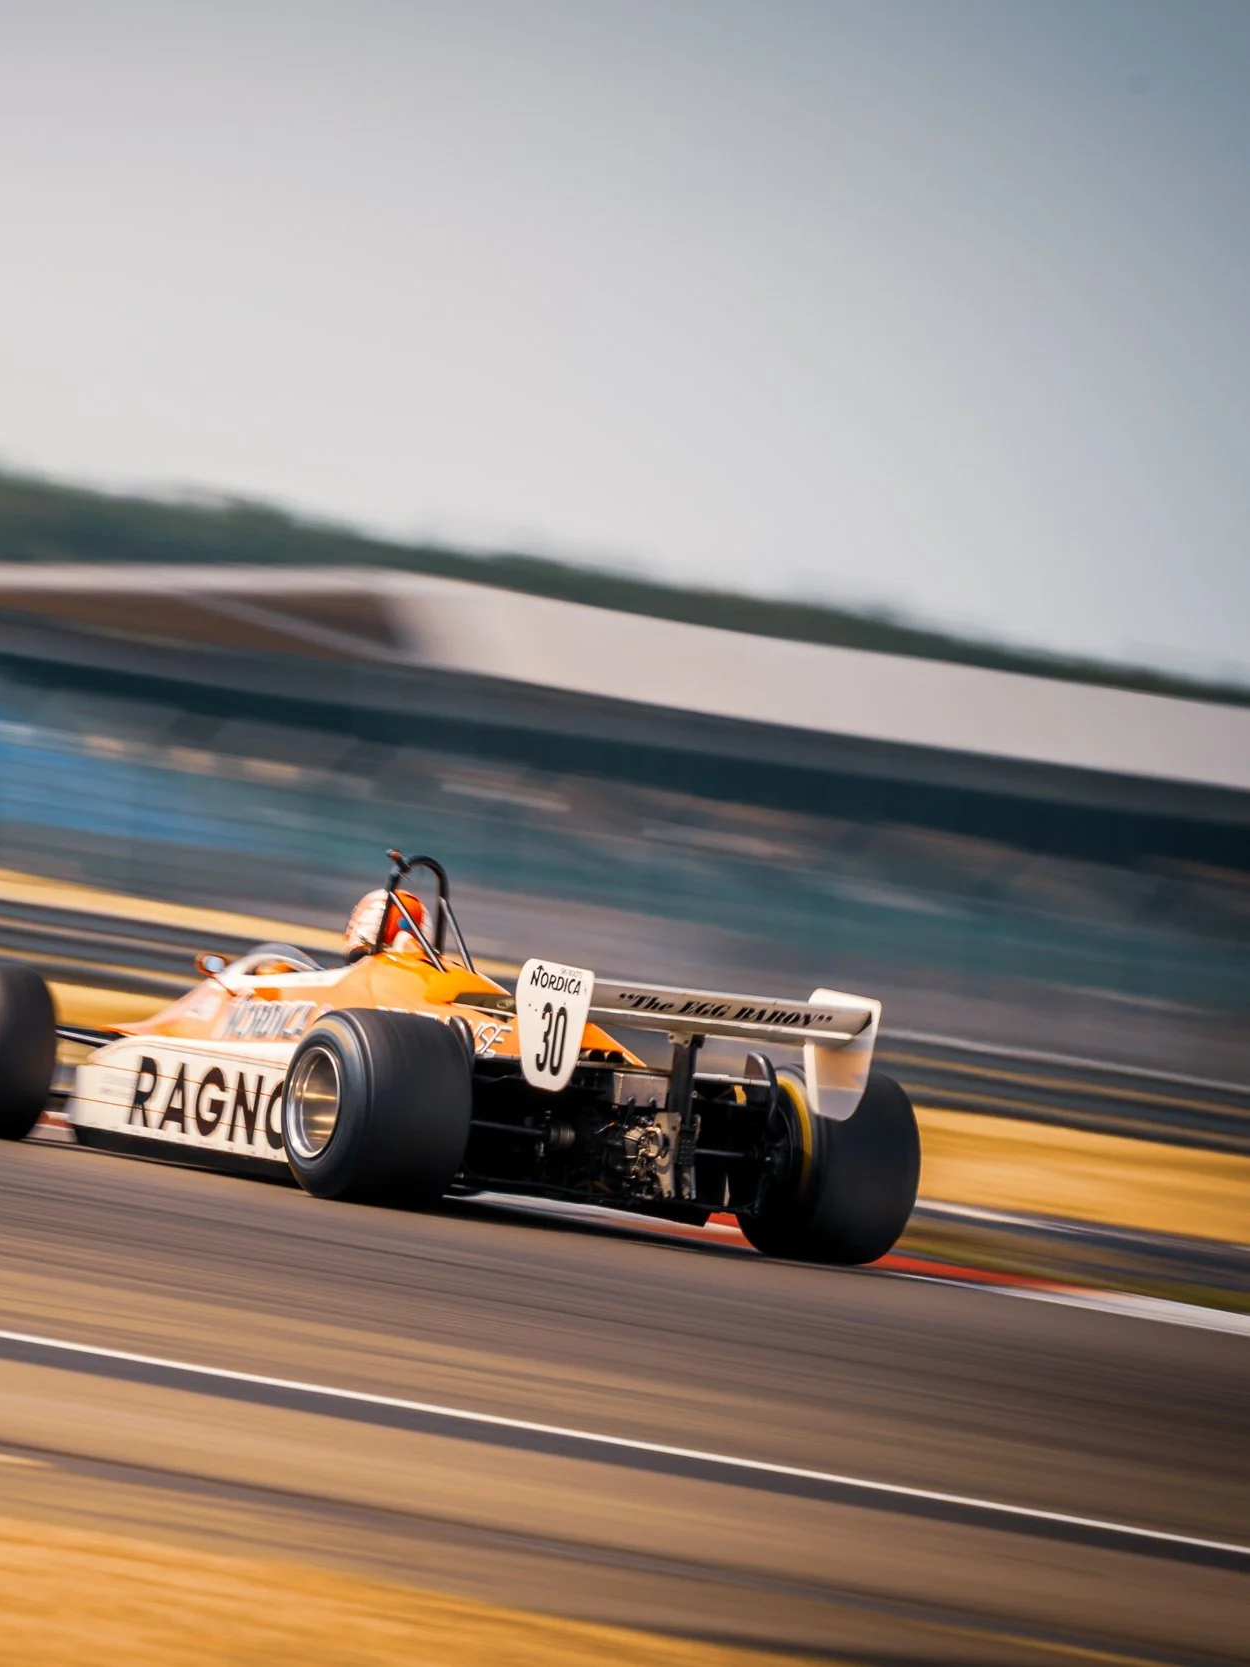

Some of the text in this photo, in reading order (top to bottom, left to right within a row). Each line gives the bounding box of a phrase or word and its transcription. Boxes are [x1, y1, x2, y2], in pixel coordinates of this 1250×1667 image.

[530, 966, 581, 996] NORDICA
[678, 1000, 731, 1018] EGG
[535, 1002, 568, 1077] 30
